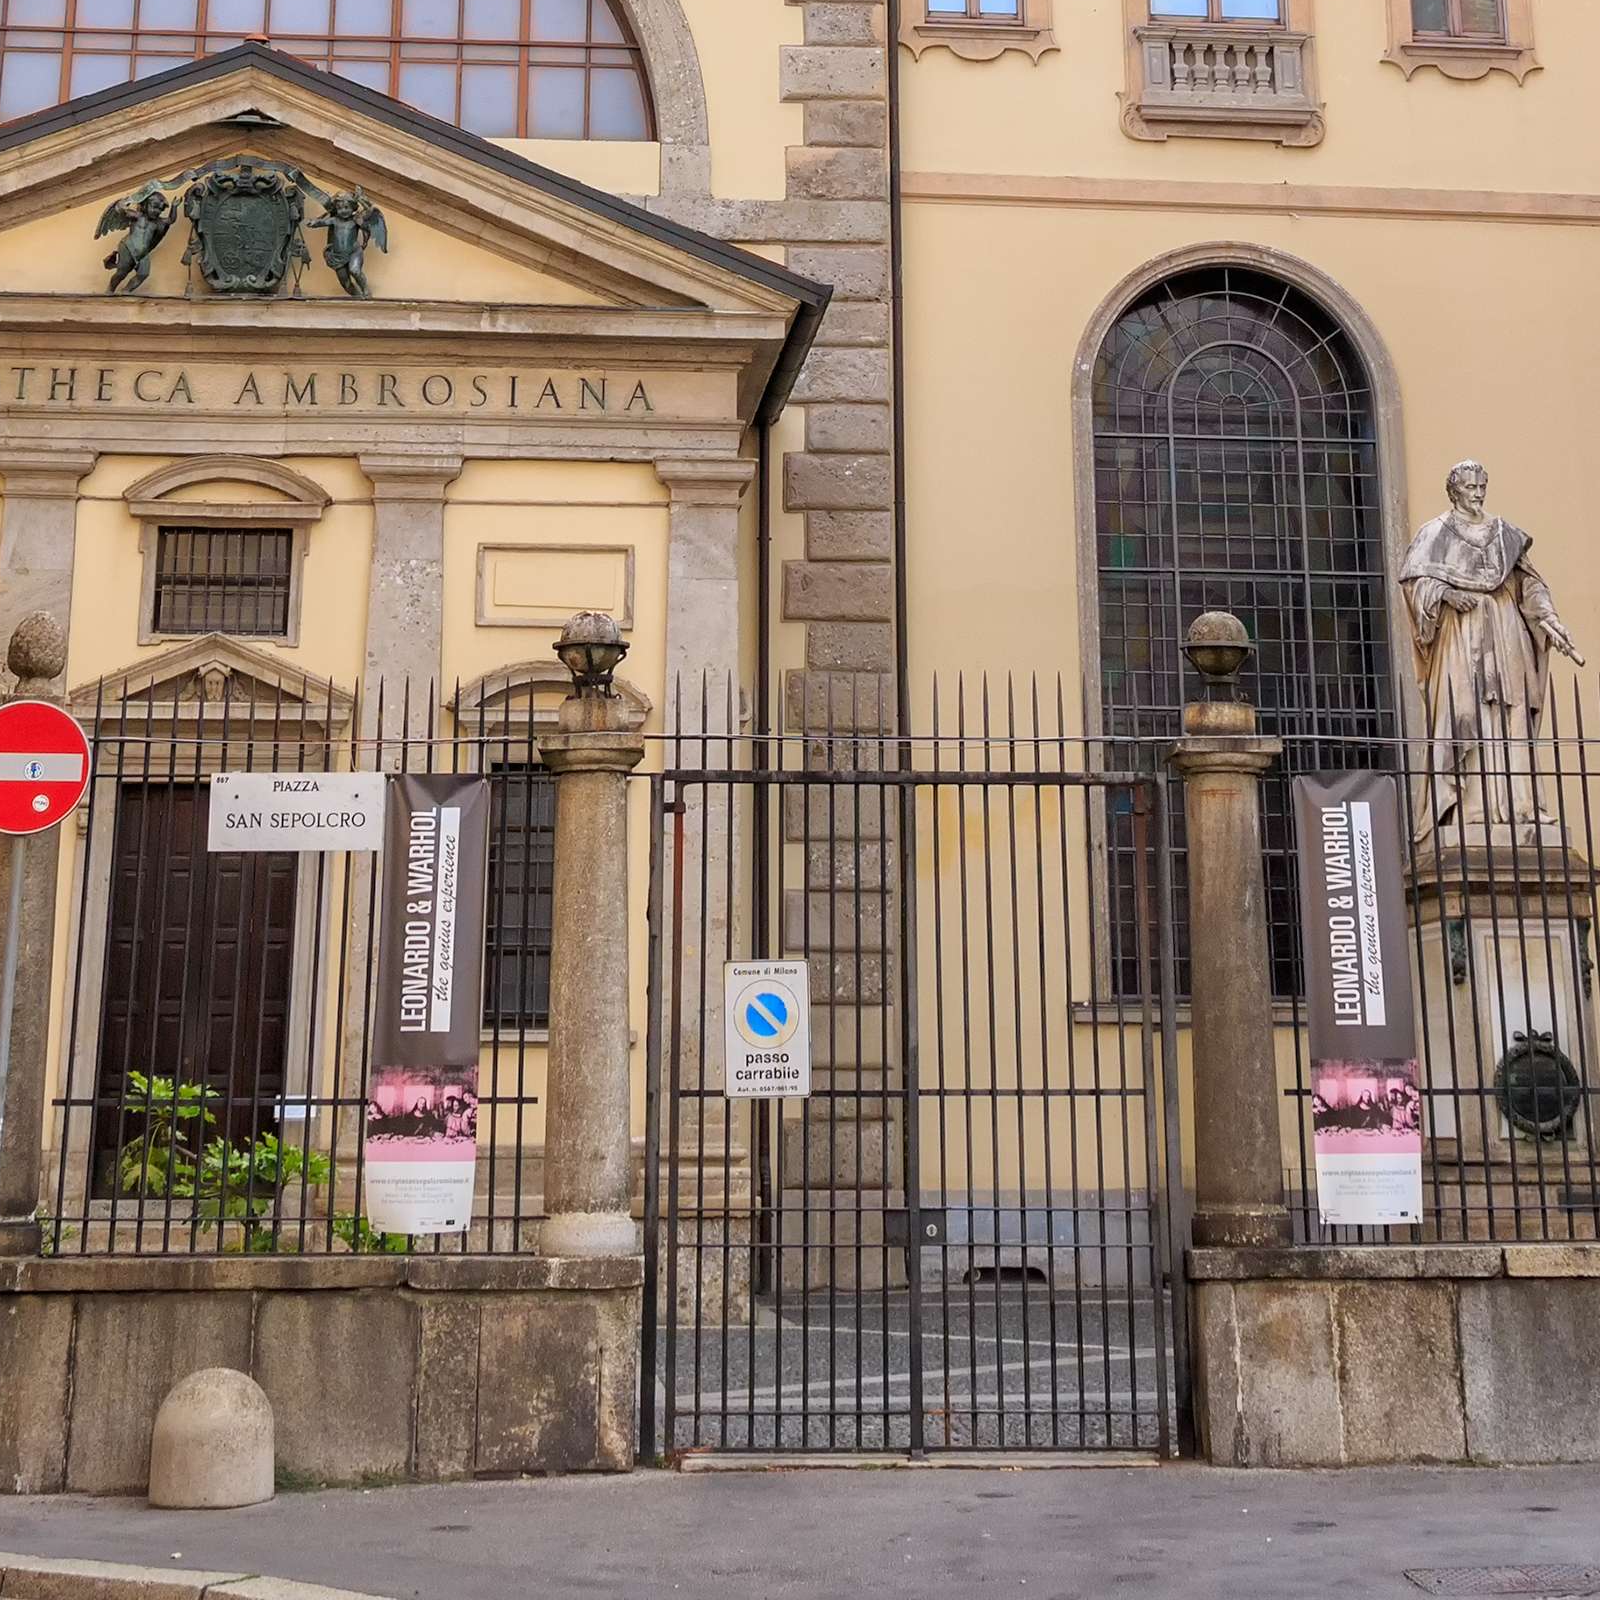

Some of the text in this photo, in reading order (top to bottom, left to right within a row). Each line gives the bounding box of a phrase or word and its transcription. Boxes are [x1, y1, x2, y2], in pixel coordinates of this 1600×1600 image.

[232, 371, 655, 412] AMBROSIANA
[272, 780, 320, 793] PIAZZA
[225, 811, 367, 829] SAN SEPOLCRO
[400, 807, 437, 1032] LEONARDO & WARHOL
[433, 834, 457, 1001] the genius experience
[1321, 801, 1362, 1026] LEONARDO & WARHOL
[1358, 830, 1382, 996] the genius experience
[732, 966, 798, 976] Comune di Milano
[745, 1052, 790, 1067] passo
